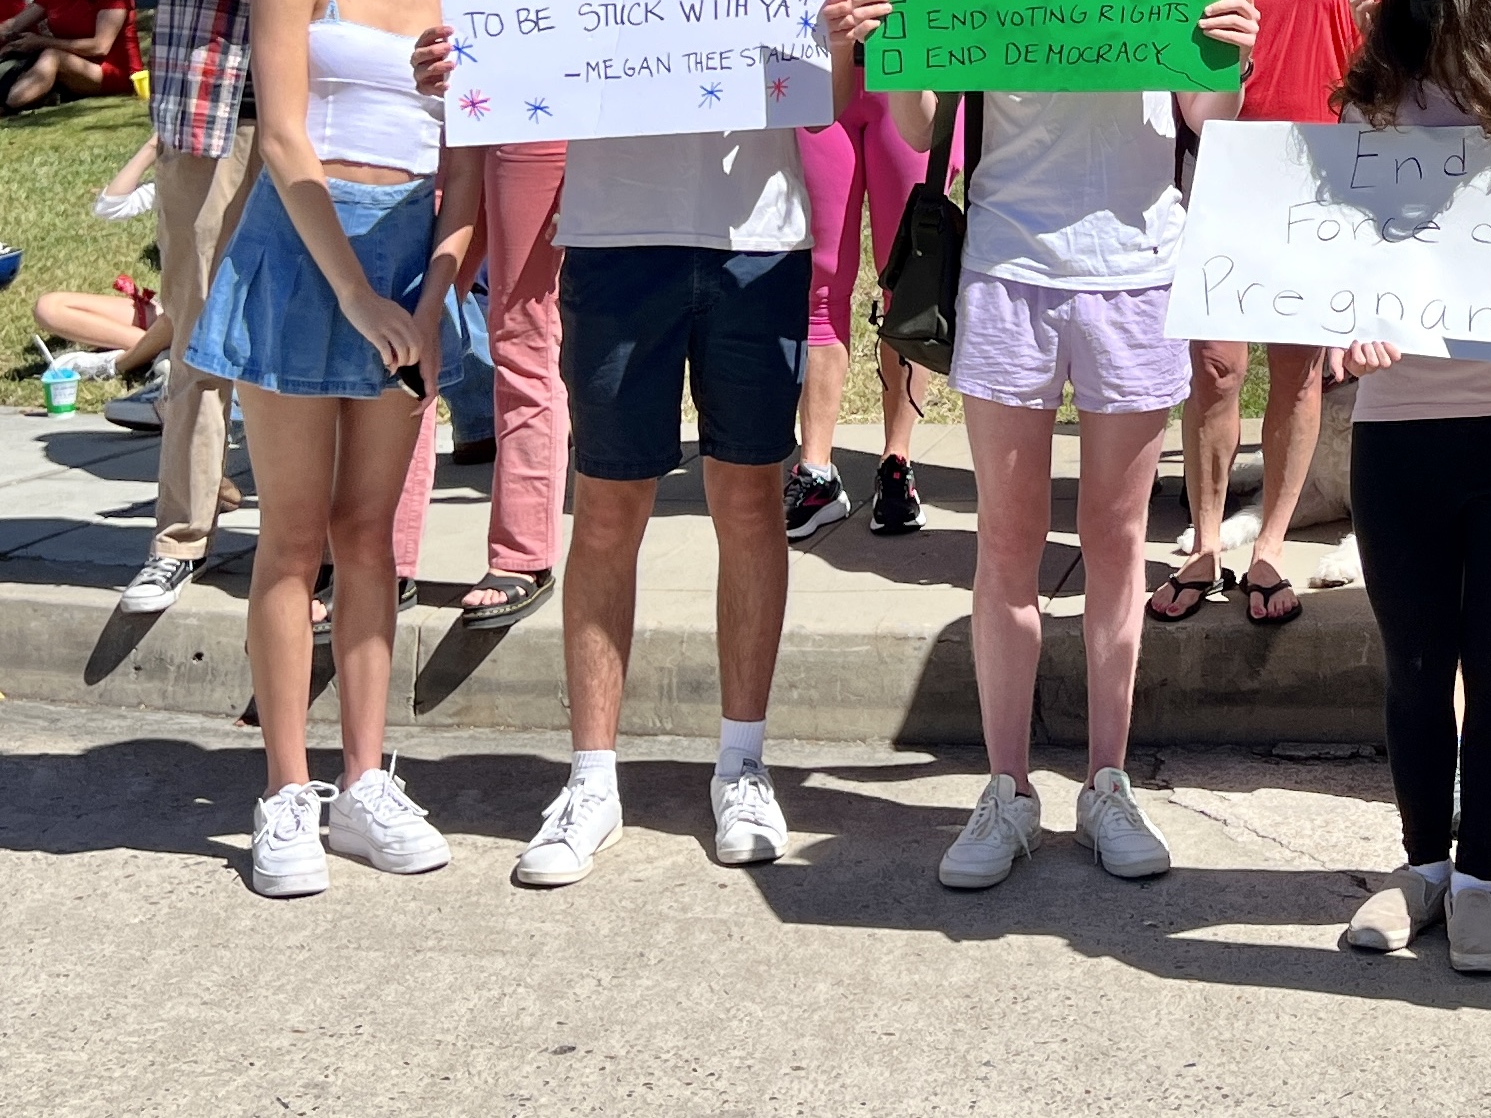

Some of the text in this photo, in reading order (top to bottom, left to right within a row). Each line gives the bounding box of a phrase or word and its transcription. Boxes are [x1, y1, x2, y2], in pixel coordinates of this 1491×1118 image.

[464, 10, 504, 39] TO
[517, 7, 556, 35] BE
[578, 0, 665, 33] STUCK
[928, 2, 1190, 30] END VOTING RIGHTS
[682, 47, 733, 73] THEE
[740, 34, 829, 69] STALLION
[926, 41, 1171, 69] END DEMOCRACY
[1350, 129, 1467, 189] End
